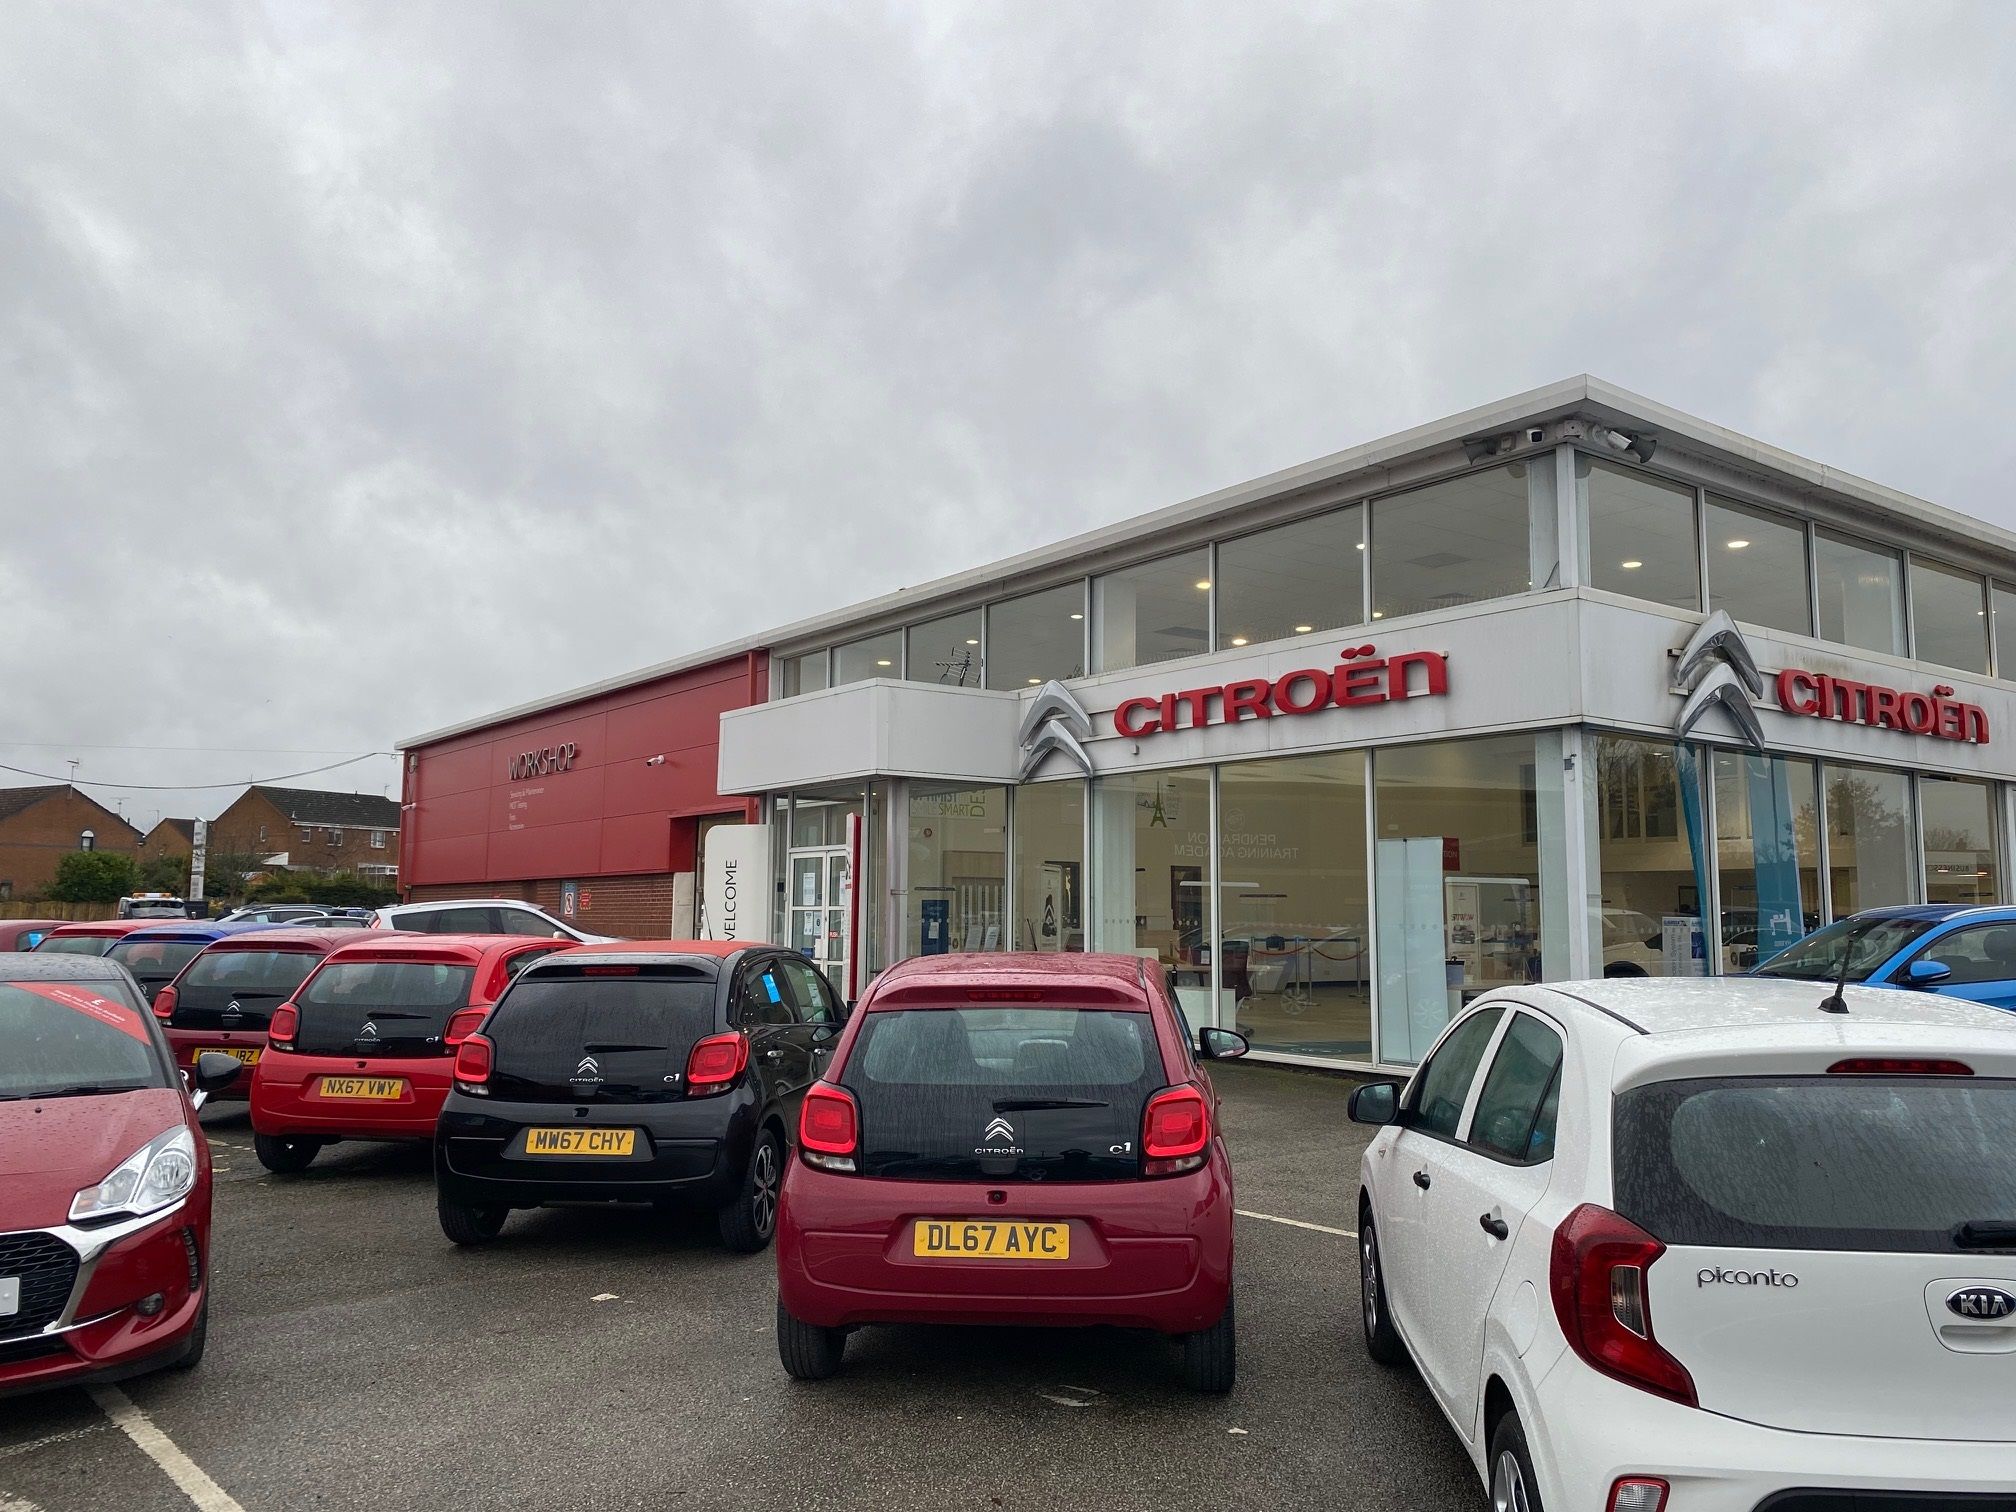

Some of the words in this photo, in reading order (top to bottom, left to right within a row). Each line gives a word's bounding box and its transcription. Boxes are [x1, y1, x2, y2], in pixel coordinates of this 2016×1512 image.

[1113, 643, 1448, 738] CITROËN
[1777, 668, 1990, 744] CITROËN
[508, 742, 576, 780] WORKSHOP
[325, 1079, 365, 1095] NX67
[367, 1080, 397, 1096] VWY
[663, 1073, 681, 1083] C1
[534, 1130, 585, 1150] MW67
[588, 1131, 627, 1151] CHY
[1109, 1141, 1132, 1155] C1
[927, 1224, 998, 1252] DL67
[1005, 1226, 1058, 1253] AYC
[1696, 1264, 1799, 1289] picanto
[1959, 1294, 2009, 1315] KIA
